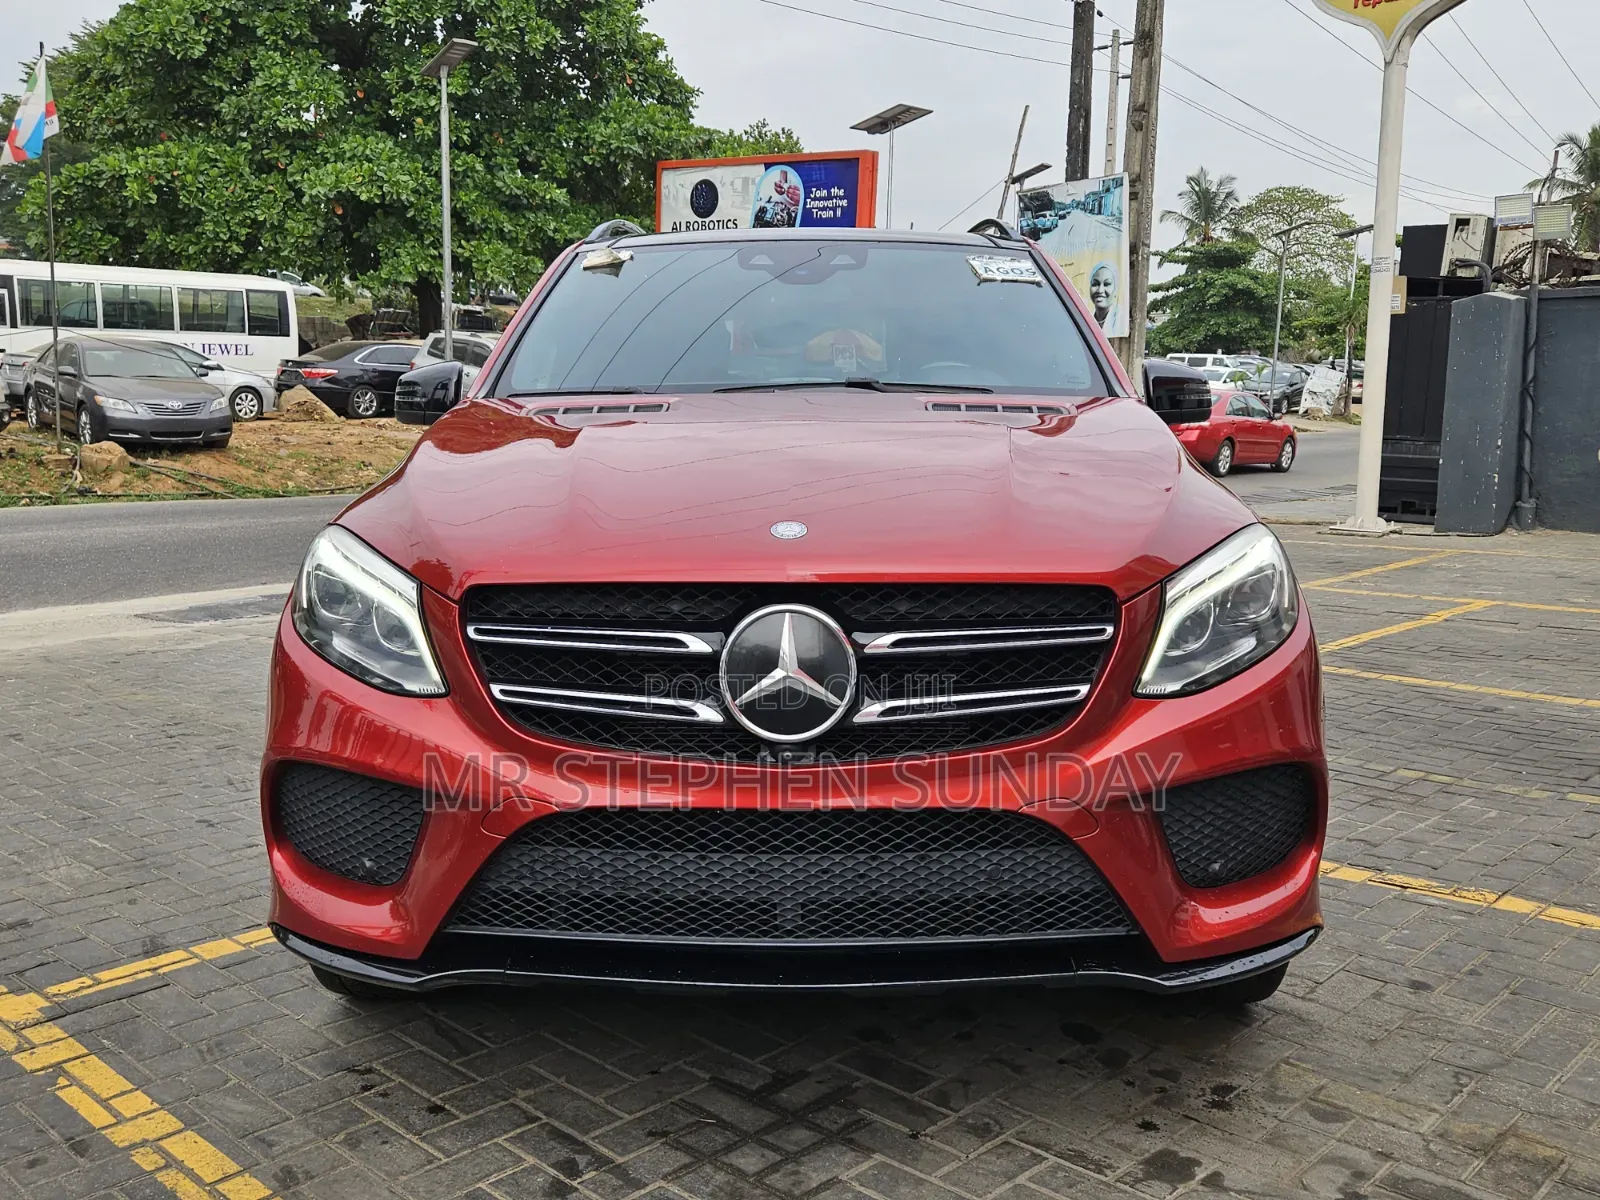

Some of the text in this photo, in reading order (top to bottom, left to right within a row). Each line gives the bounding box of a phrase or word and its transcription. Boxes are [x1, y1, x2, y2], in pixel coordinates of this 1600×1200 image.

[810, 186, 845, 198] Join the
[806, 197, 848, 208] Innovative
[812, 208, 834, 218] Train
[685, 219, 738, 232] ROBOTICS
